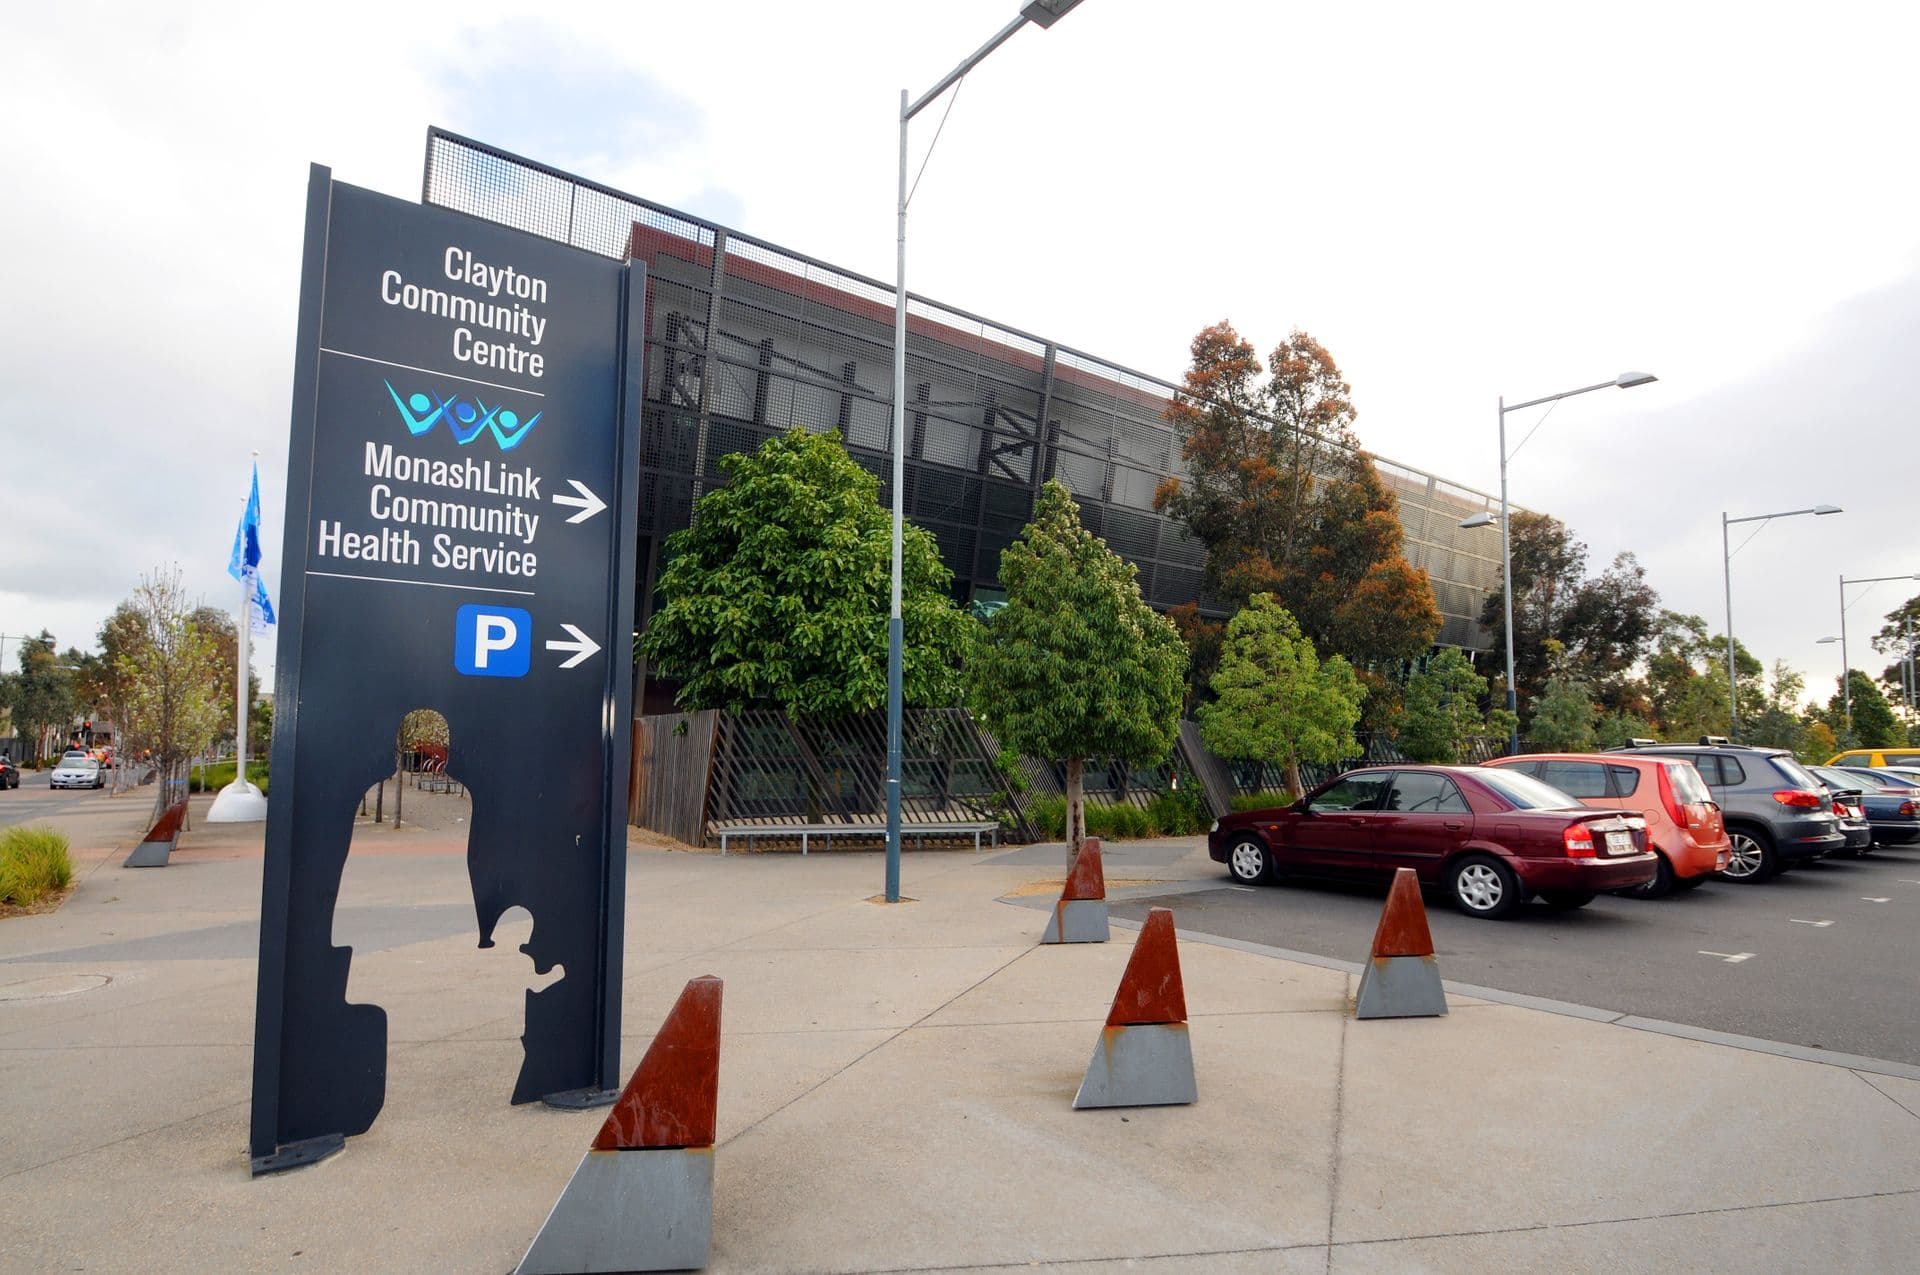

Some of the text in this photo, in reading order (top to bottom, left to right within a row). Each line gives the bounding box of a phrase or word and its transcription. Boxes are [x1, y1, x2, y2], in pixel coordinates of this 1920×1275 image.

[445, 247, 547, 303] Clayton
[381, 271, 546, 345] Community
[453, 328, 544, 377] Centre
[365, 442, 541, 500] MonashLink
[370, 484, 539, 544] Community
[319, 520, 537, 577] Health Service
[475, 615, 517, 668] P
